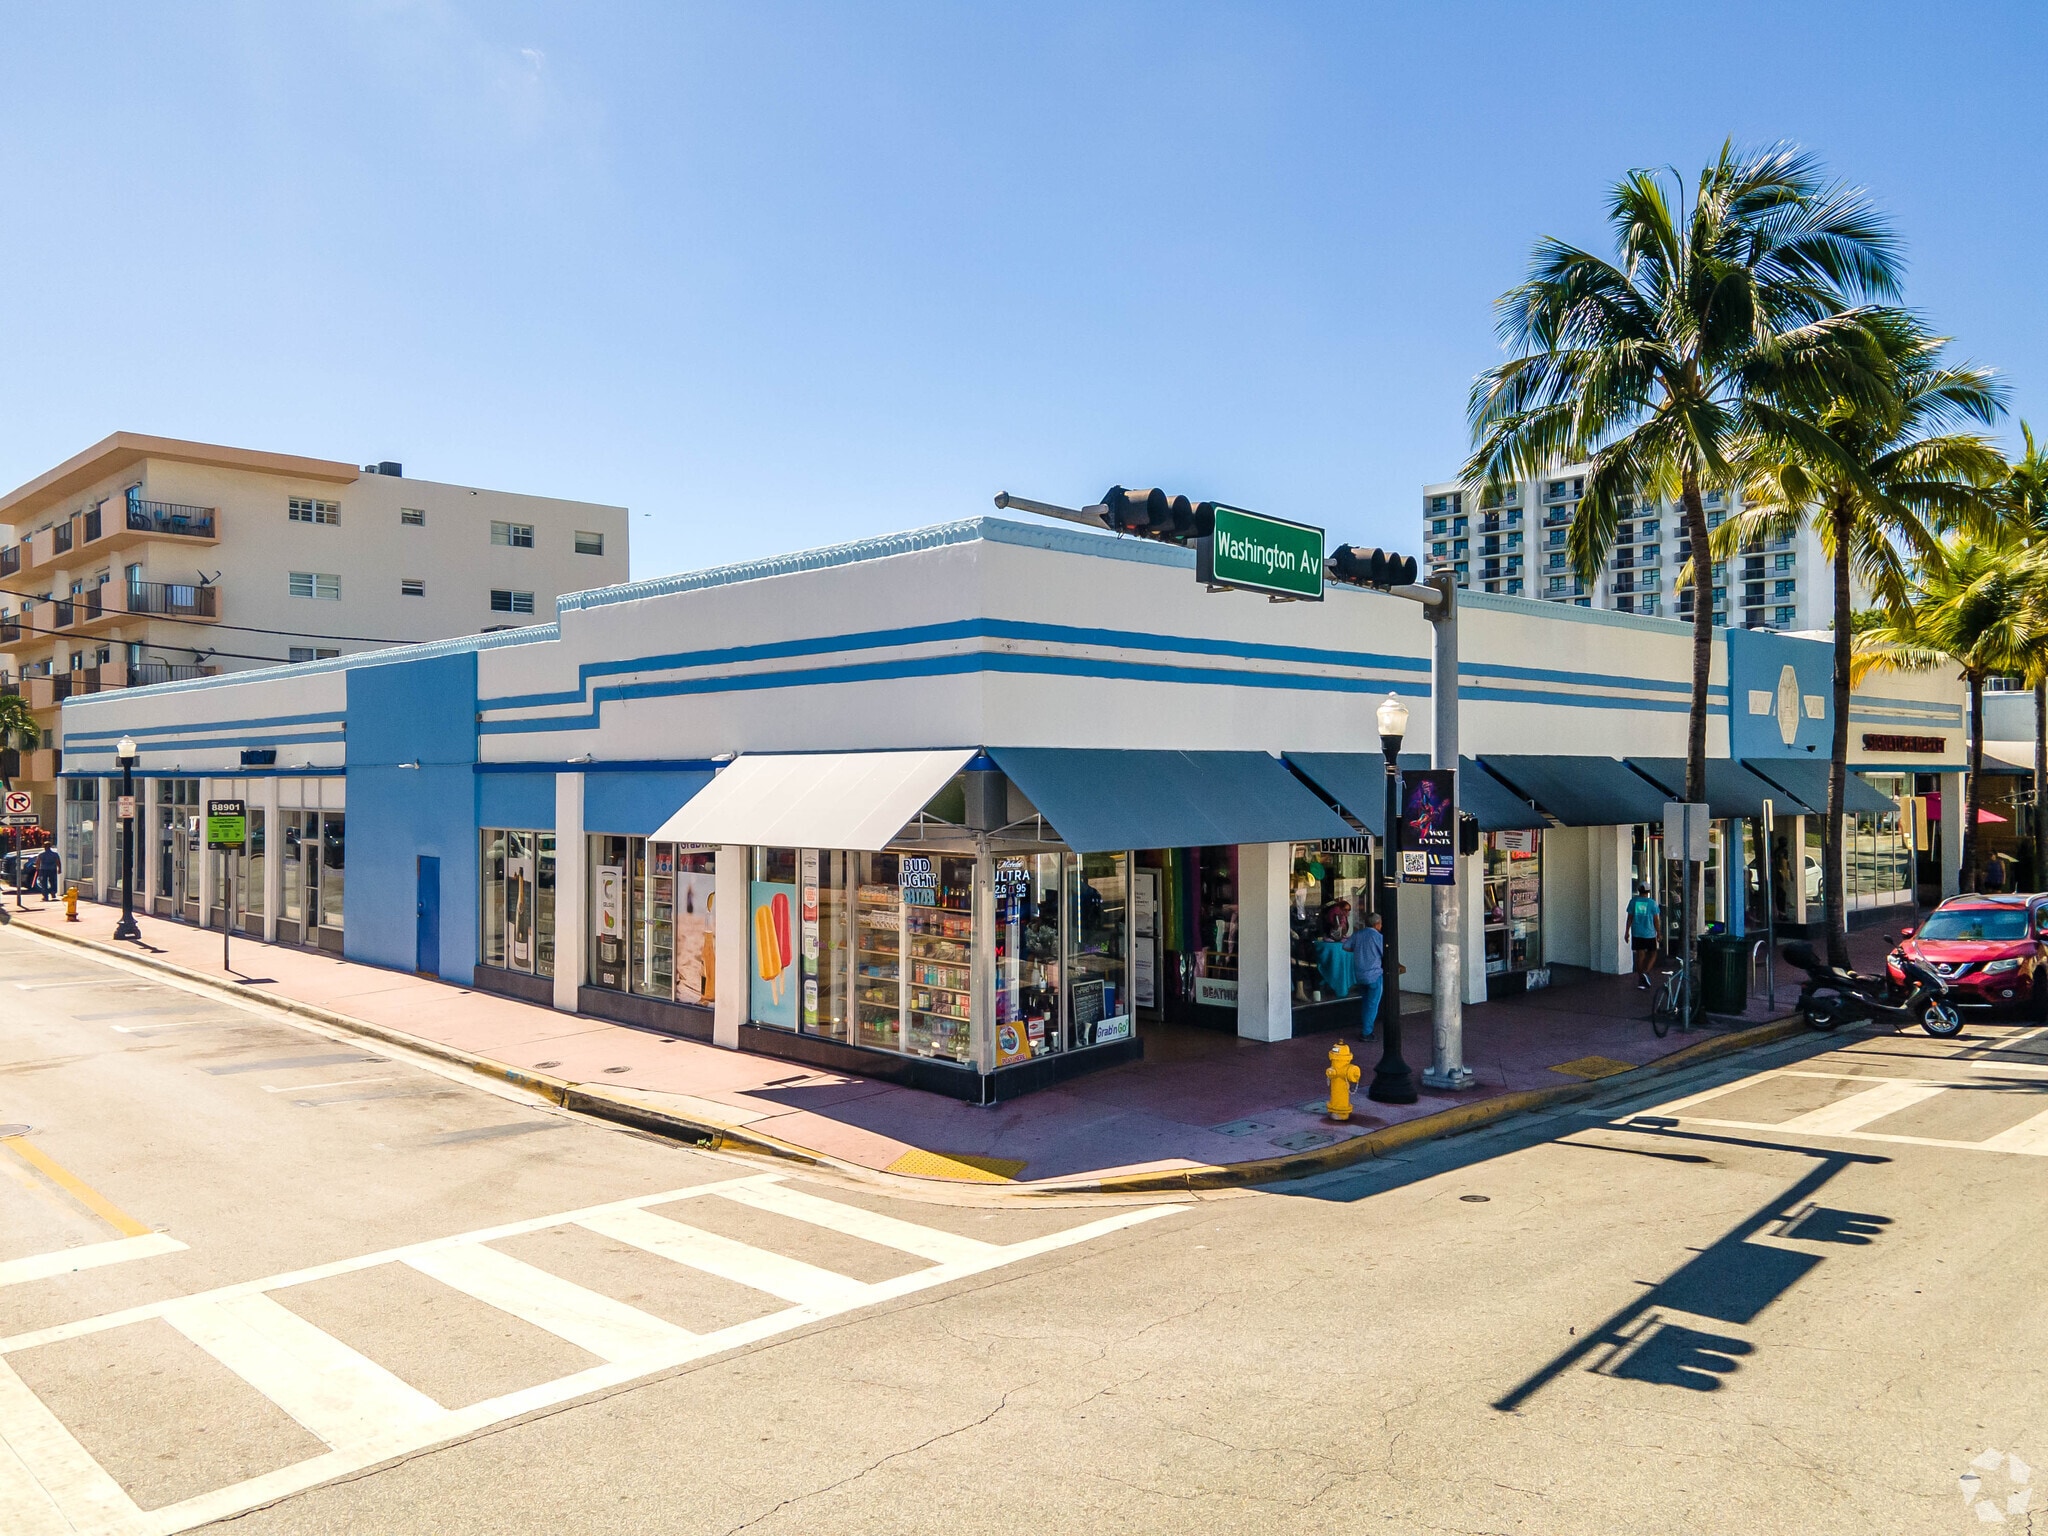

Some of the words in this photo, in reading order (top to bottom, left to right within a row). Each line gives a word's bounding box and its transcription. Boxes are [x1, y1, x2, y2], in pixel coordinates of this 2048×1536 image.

[1218, 530, 1295, 575] Washington
[1300, 549, 1319, 575] Av
[1321, 836, 1370, 854] BEATNIX
[903, 858, 931, 873] BUD
[898, 872, 938, 887] LIGHT
[1016, 883, 1027, 893] 95
